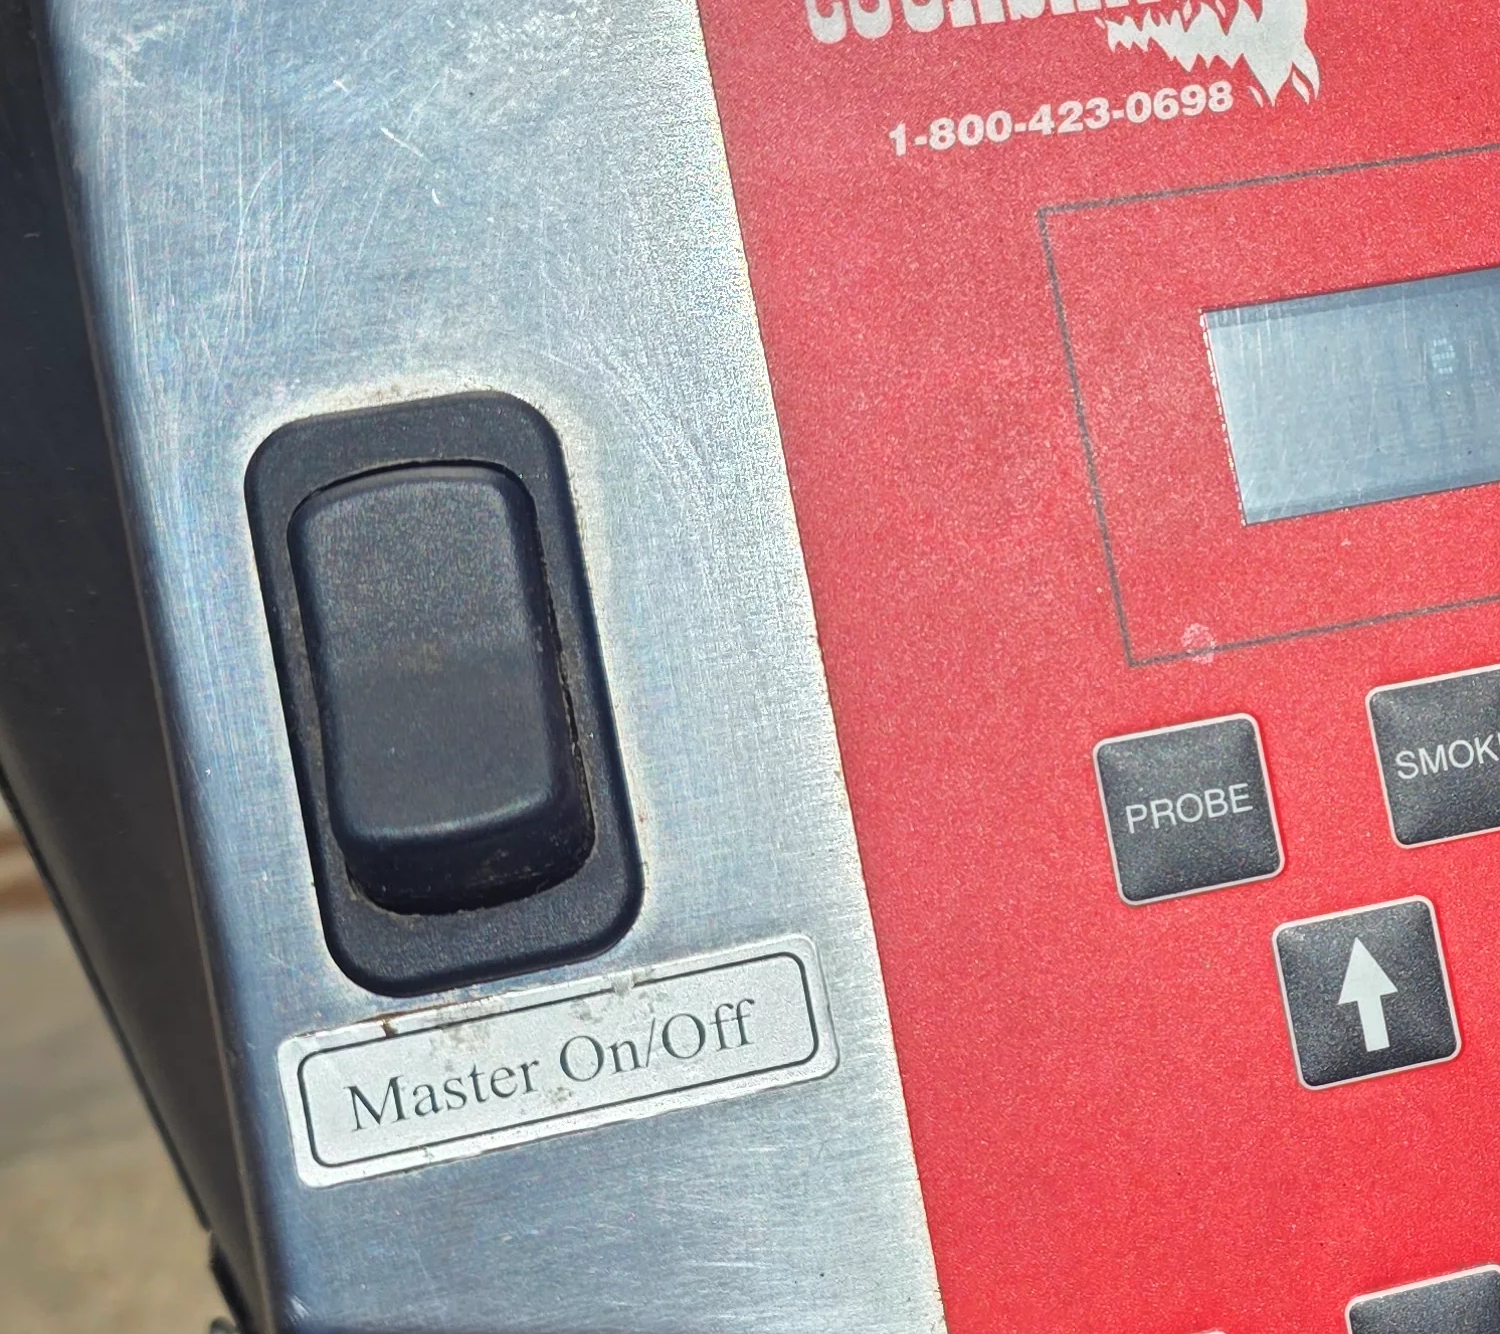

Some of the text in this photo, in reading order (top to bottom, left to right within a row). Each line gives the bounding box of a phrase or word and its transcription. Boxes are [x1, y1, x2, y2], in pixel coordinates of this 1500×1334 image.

[889, 81, 1233, 156] 1-800-423-0698
[1126, 783, 1253, 834] PROBE
[345, 998, 755, 1133] Master On/Off
